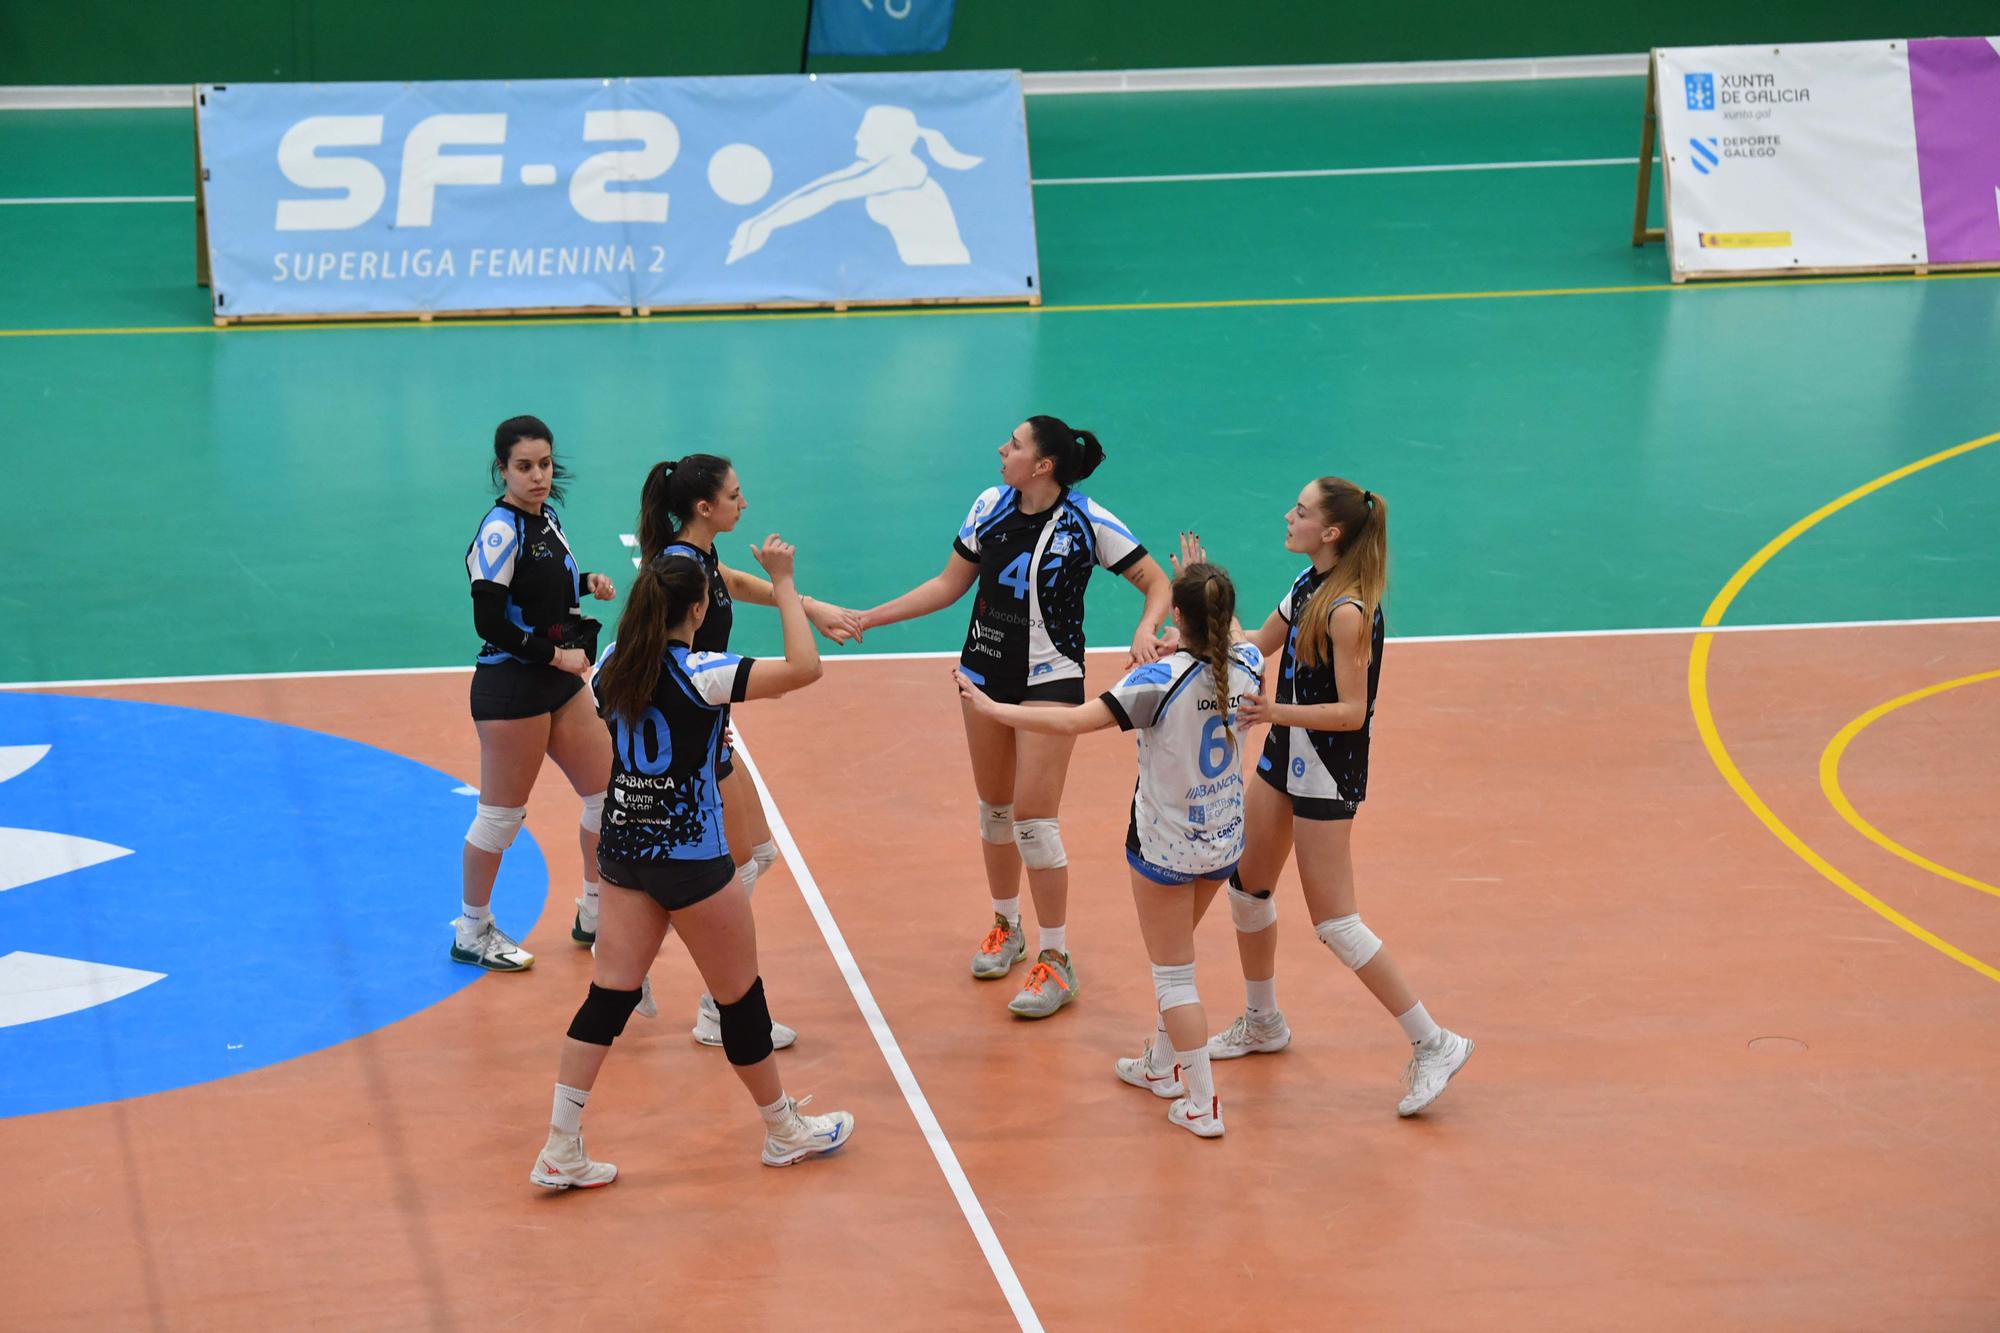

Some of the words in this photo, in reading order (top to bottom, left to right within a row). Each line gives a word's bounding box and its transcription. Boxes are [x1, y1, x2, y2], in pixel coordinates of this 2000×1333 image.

[1720, 74, 1775, 88] XUNTA
[1721, 91, 1741, 105] DE
[1744, 88, 1810, 104] GALICIA
[1723, 135, 1781, 147] DEPORTE
[1724, 146, 1776, 158] GALEGO
[275, 110, 680, 231] SF-2
[273, 249, 455, 282] SUPERLIGA
[469, 245, 636, 277] FEMENINA
[648, 246, 665, 272] 2
[998, 551, 1031, 600] 4
[609, 705, 673, 776] 10
[1198, 713, 1236, 779] 6
[626, 793, 653, 804] XUNTA
